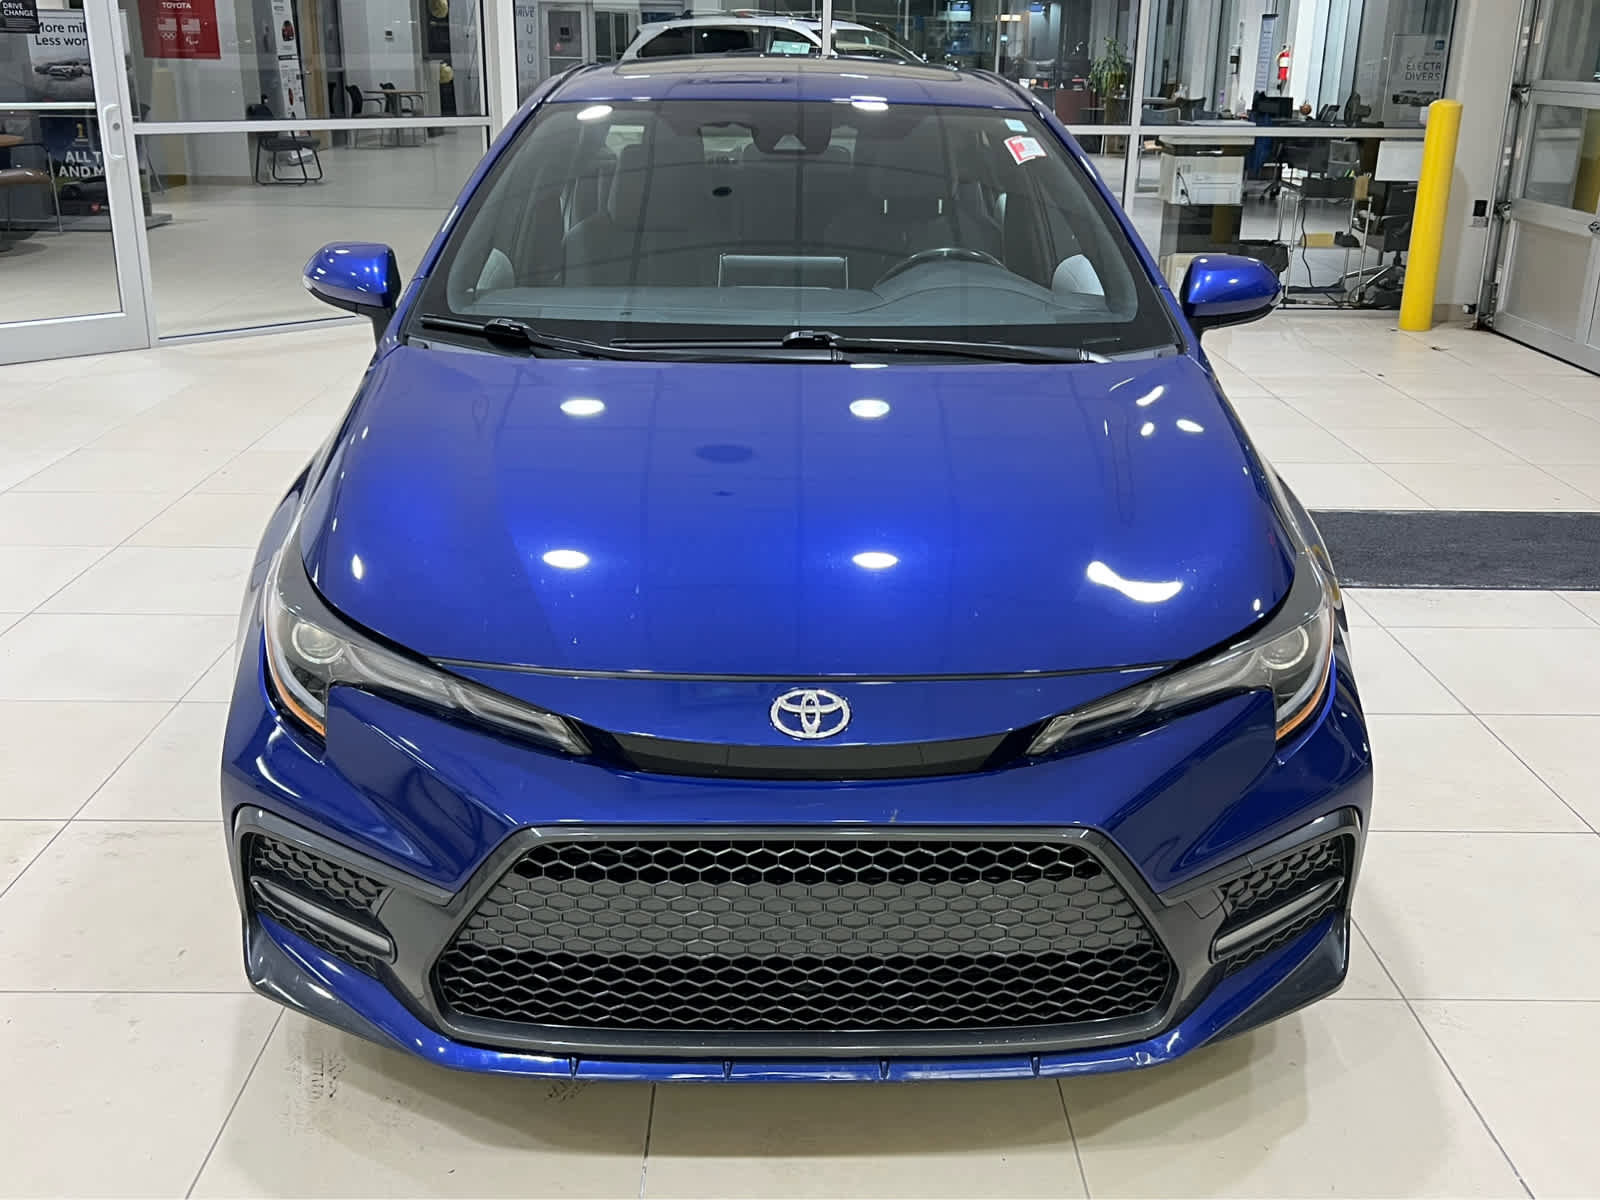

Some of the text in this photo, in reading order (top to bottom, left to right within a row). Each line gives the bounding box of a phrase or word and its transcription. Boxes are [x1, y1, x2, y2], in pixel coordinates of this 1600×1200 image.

[3, 9, 34, 17] CHANGE
[35, 35, 61, 46] Less
[1405, 72, 1441, 81] DIVERS
[65, 151, 91, 163] ALL
[59, 166, 91, 178] AND
